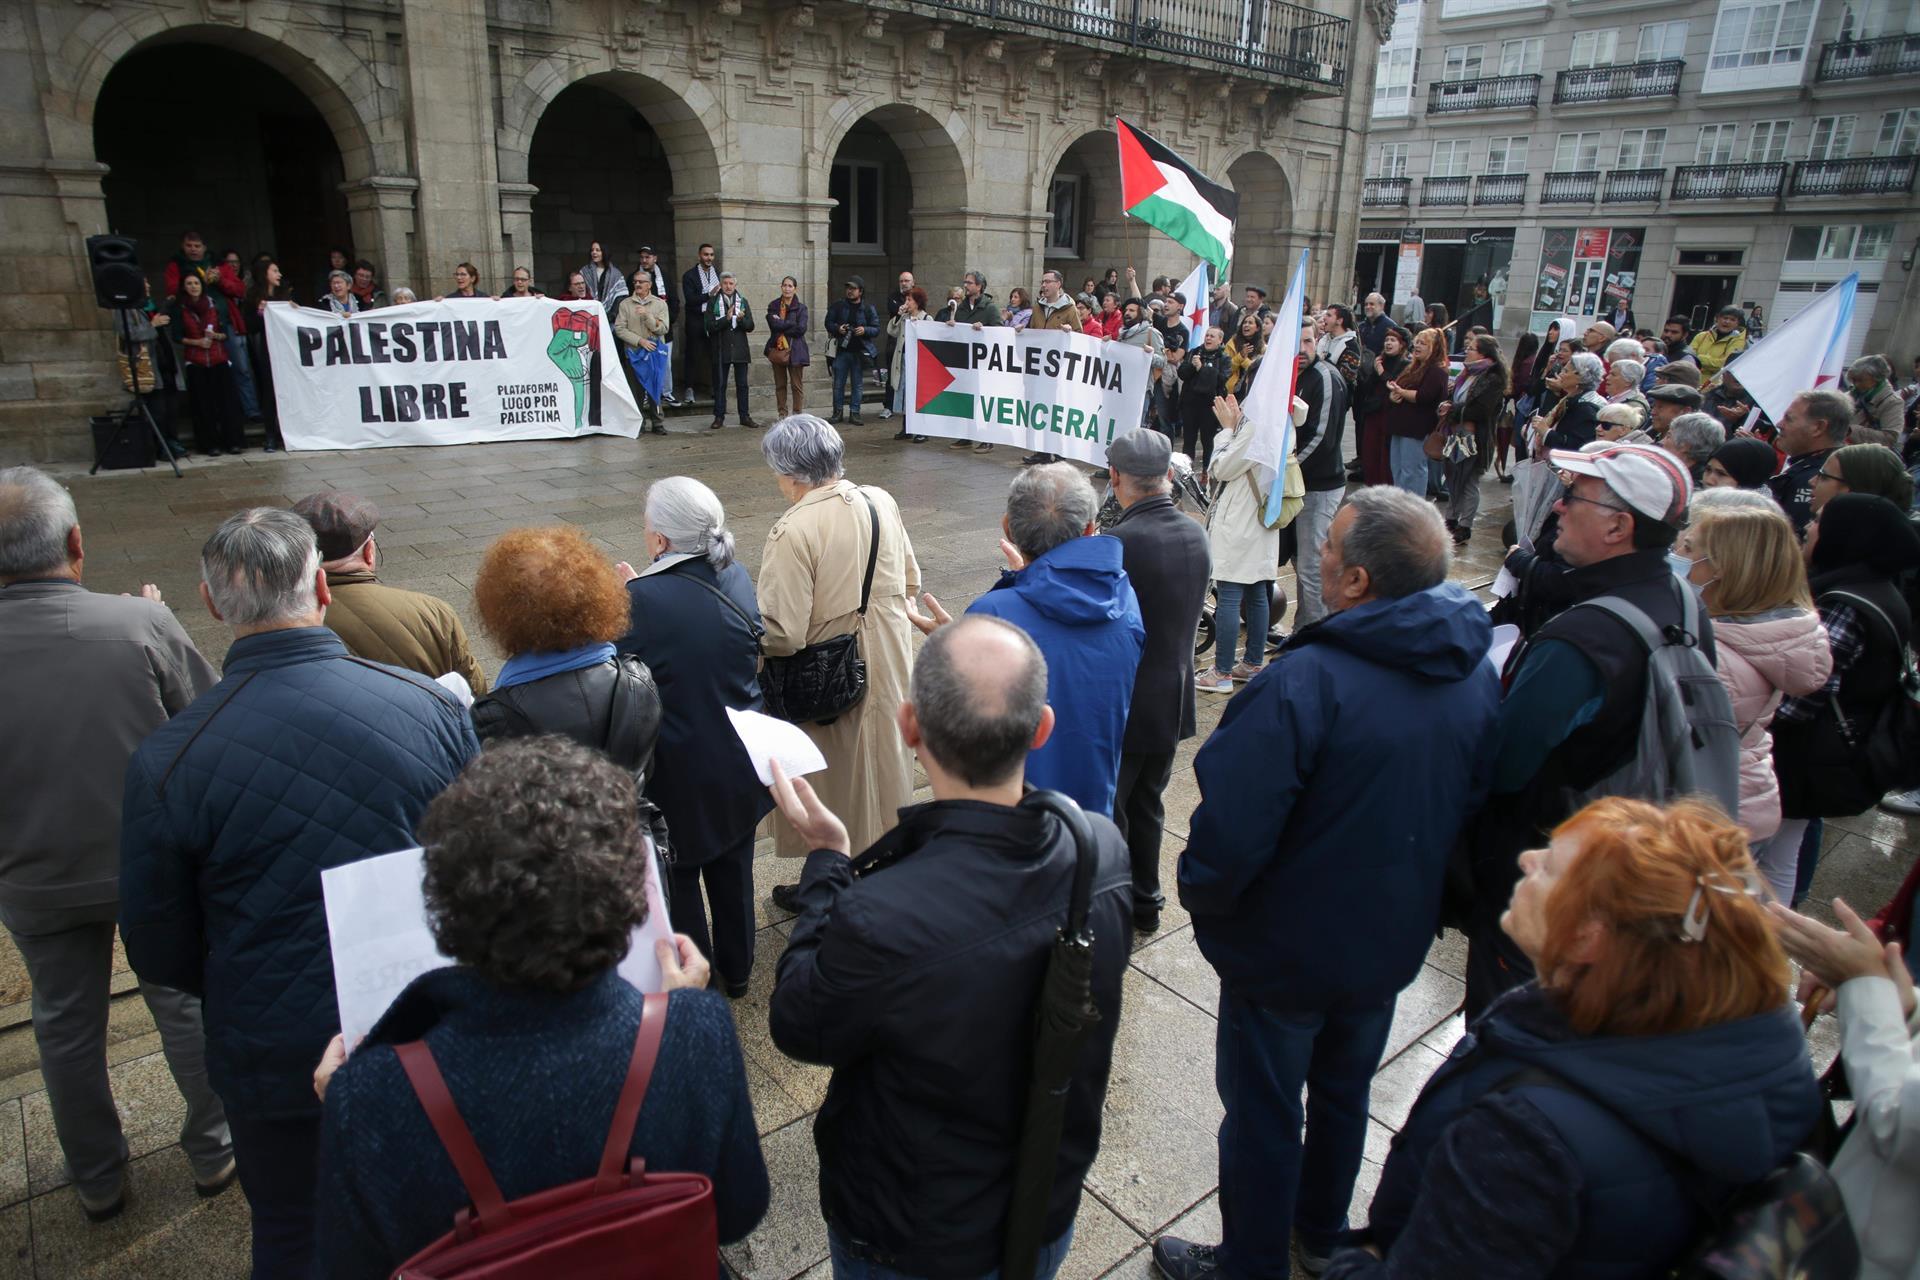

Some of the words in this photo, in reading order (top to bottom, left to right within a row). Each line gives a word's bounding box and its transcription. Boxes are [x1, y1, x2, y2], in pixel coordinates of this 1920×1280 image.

[297, 321, 507, 366] PALESTINA
[972, 343, 1123, 393] PALESTINA
[359, 382, 469, 423] LIBRE
[497, 382, 559, 396] PLATAFORMA
[501, 397, 532, 410] LUGO
[533, 395, 557, 408] POR
[500, 410, 561, 425] PALESTINA
